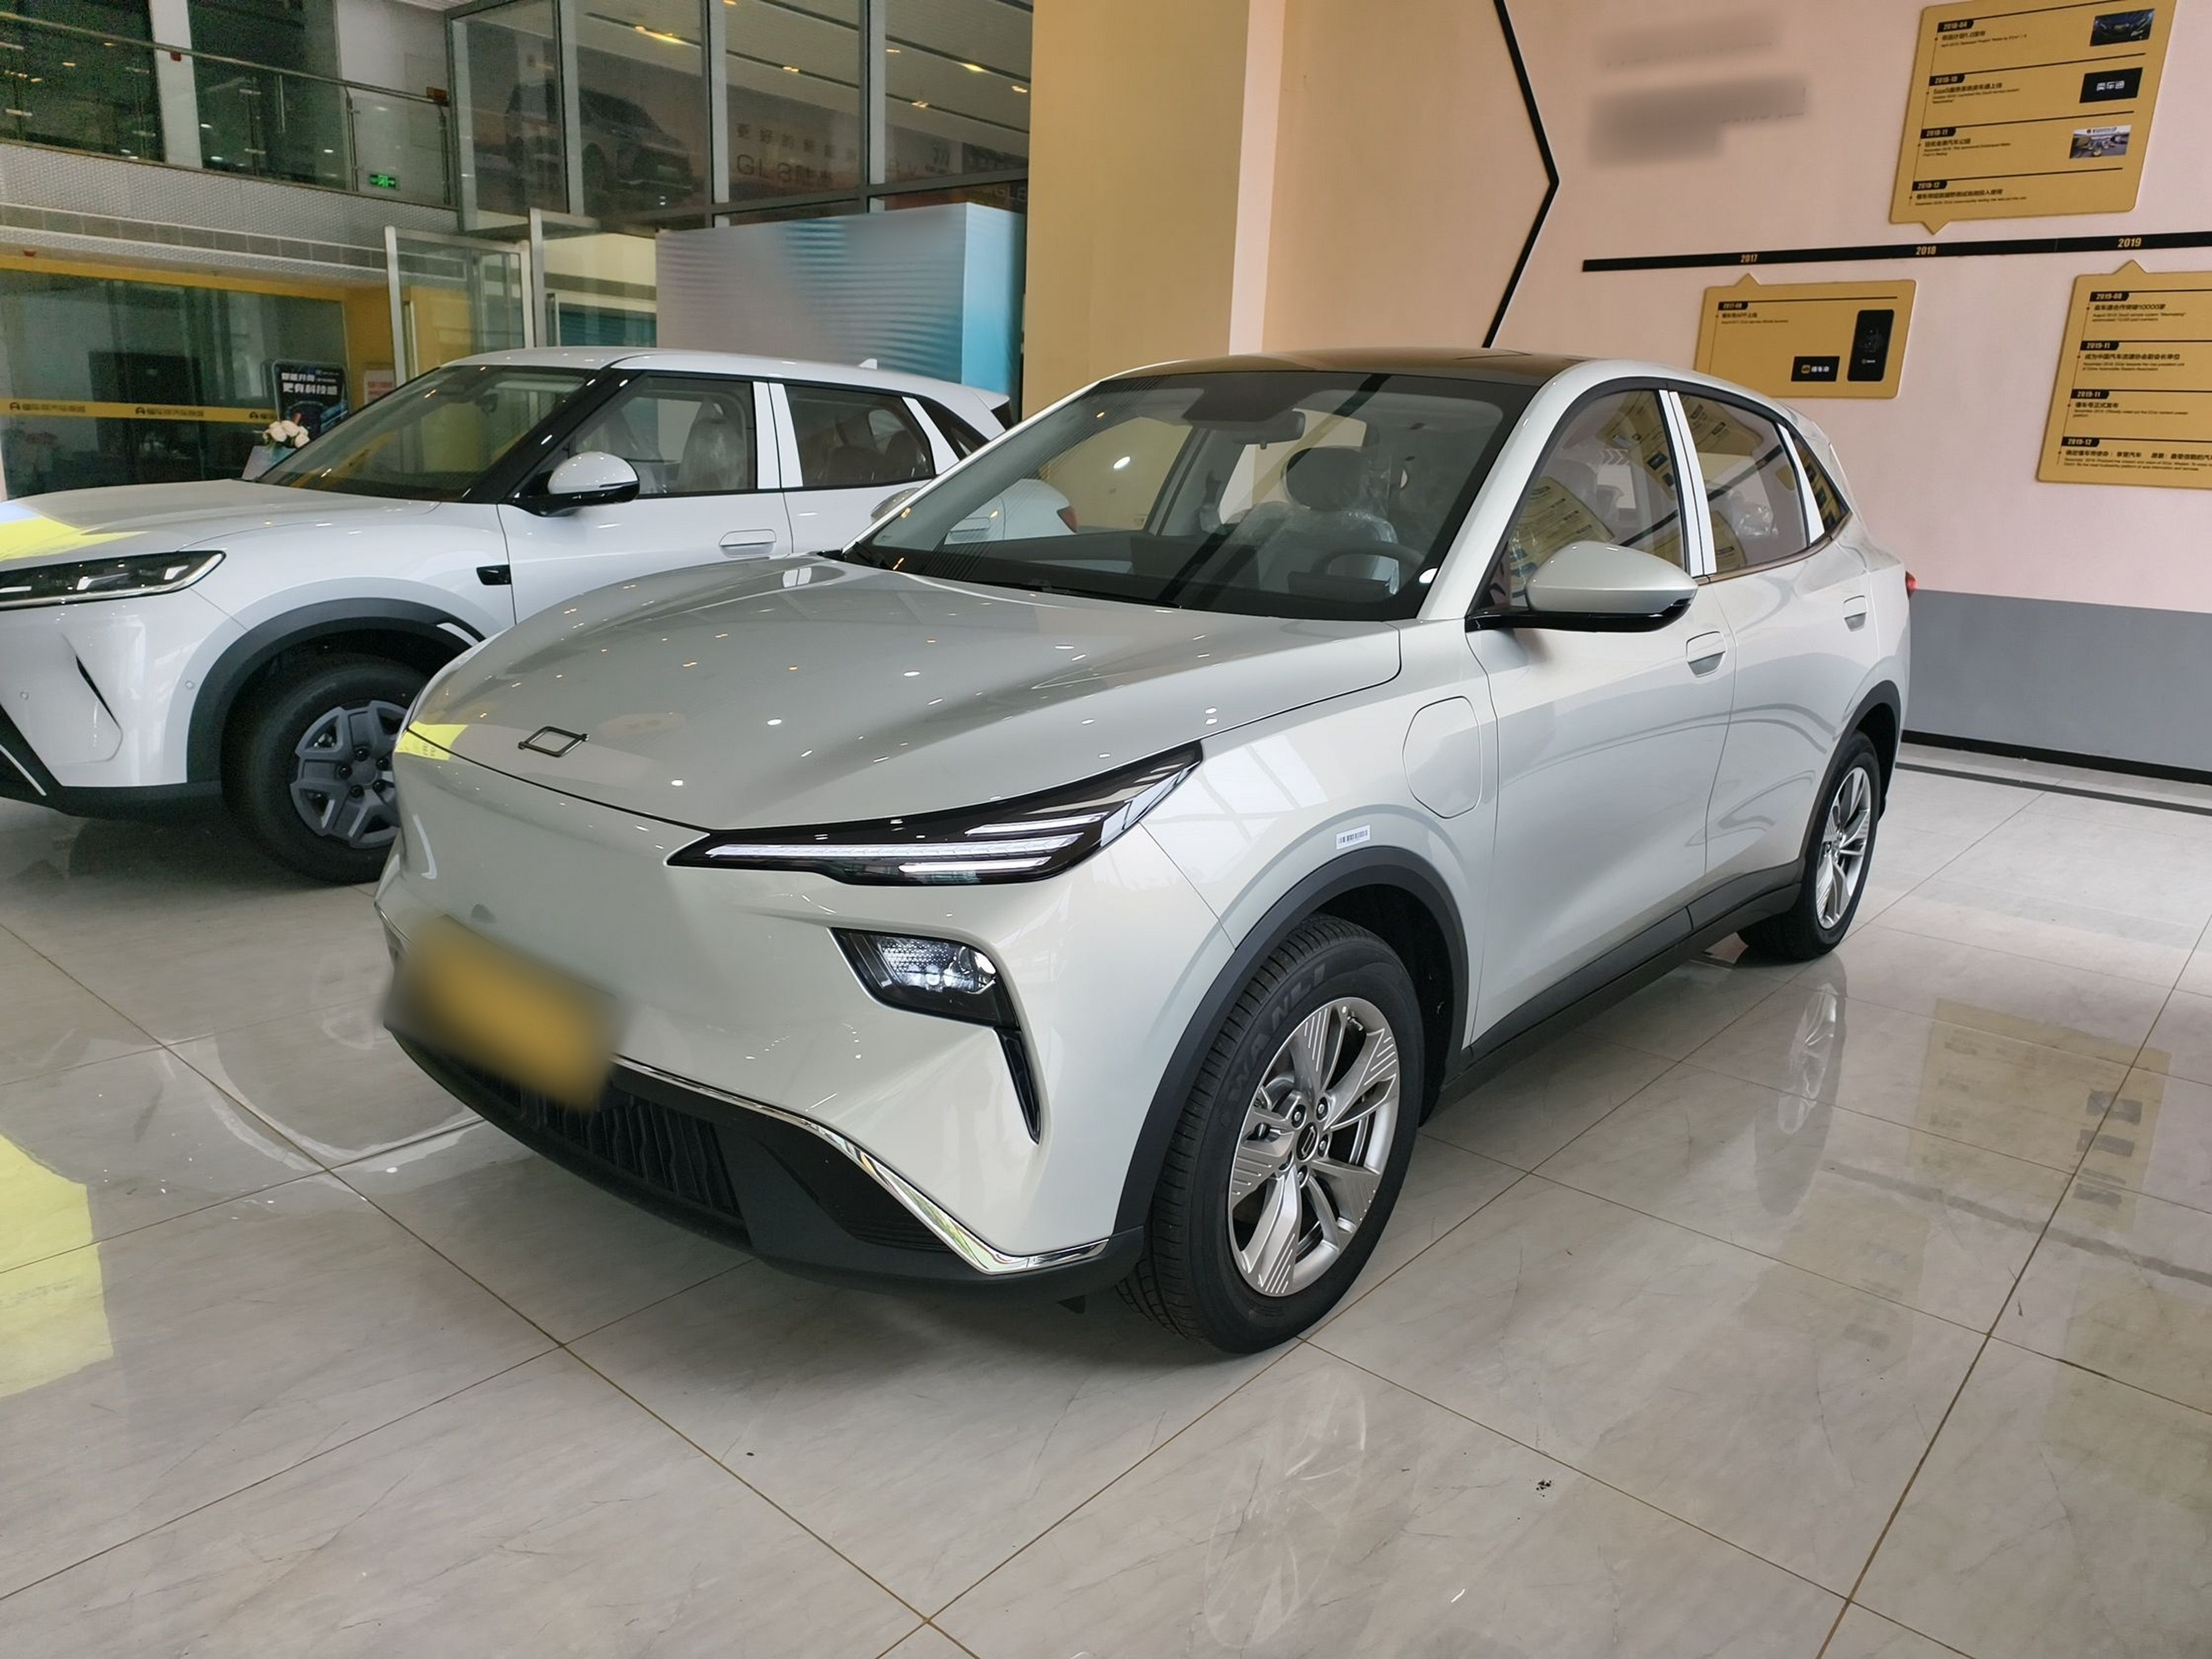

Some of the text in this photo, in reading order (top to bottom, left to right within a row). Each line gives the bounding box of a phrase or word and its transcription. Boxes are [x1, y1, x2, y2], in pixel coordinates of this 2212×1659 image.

[2117, 237, 2142, 248] 2019
[1915, 245, 1937, 255] 2018
[1740, 254, 1759, 263] 2017
